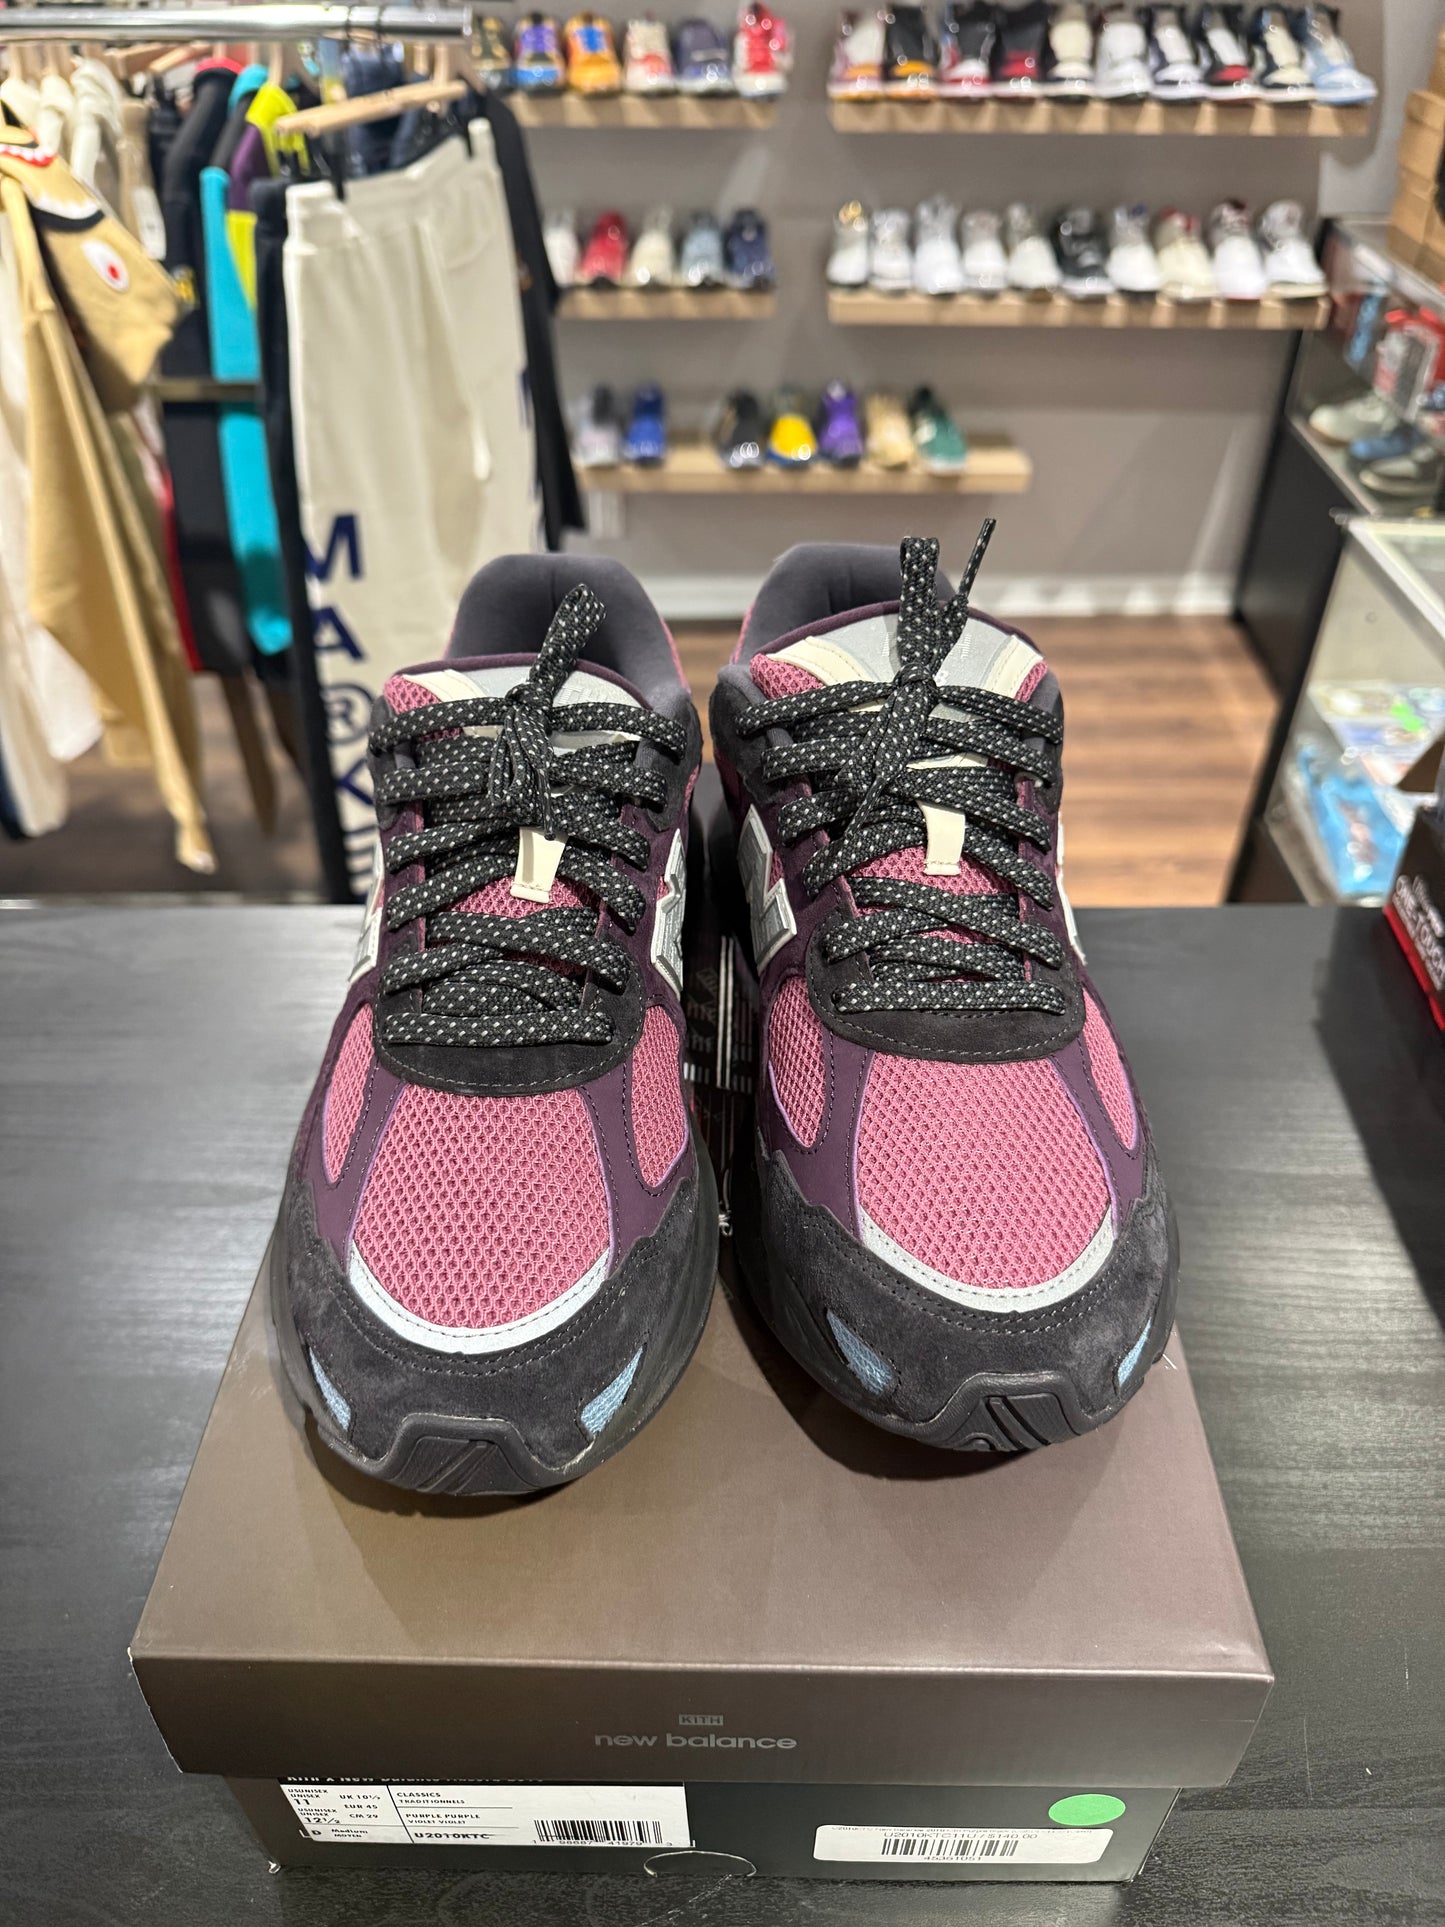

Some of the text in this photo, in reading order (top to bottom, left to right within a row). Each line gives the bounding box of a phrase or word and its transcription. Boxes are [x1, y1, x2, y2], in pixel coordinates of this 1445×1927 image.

[681, 1715, 722, 1725] KITH
[594, 1733, 798, 1750] new balance
[414, 1832, 490, 1840] U2010KTC
